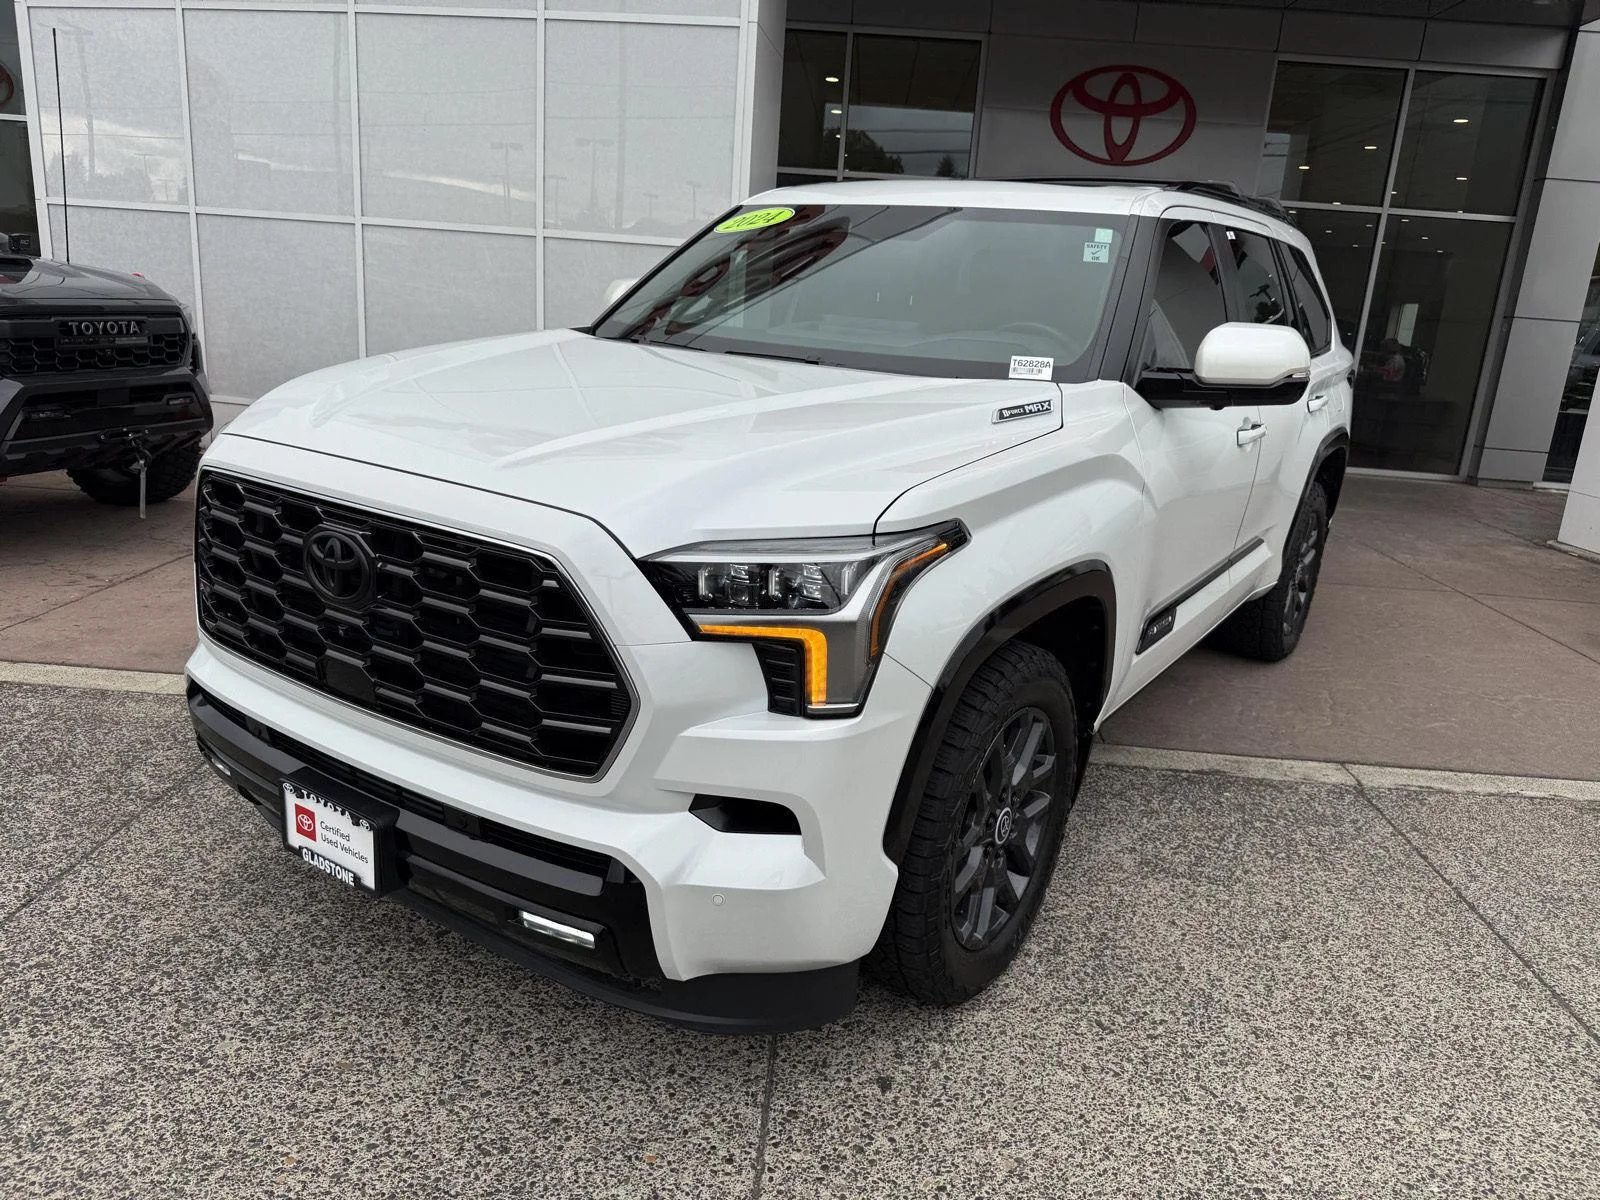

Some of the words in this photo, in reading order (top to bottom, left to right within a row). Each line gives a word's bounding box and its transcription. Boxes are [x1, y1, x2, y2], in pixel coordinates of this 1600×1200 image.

[723, 210, 785, 229] 2024
[68, 321, 141, 336] TOYOTA
[1012, 359, 1051, 369] T62828A
[1024, 401, 1051, 414] MAX
[300, 789, 353, 821] TOYOTA
[319, 820, 351, 842] Certified
[320, 832, 339, 849] Used
[339, 841, 369, 864] Vehicles
[302, 846, 355, 887] GLADSTONE
